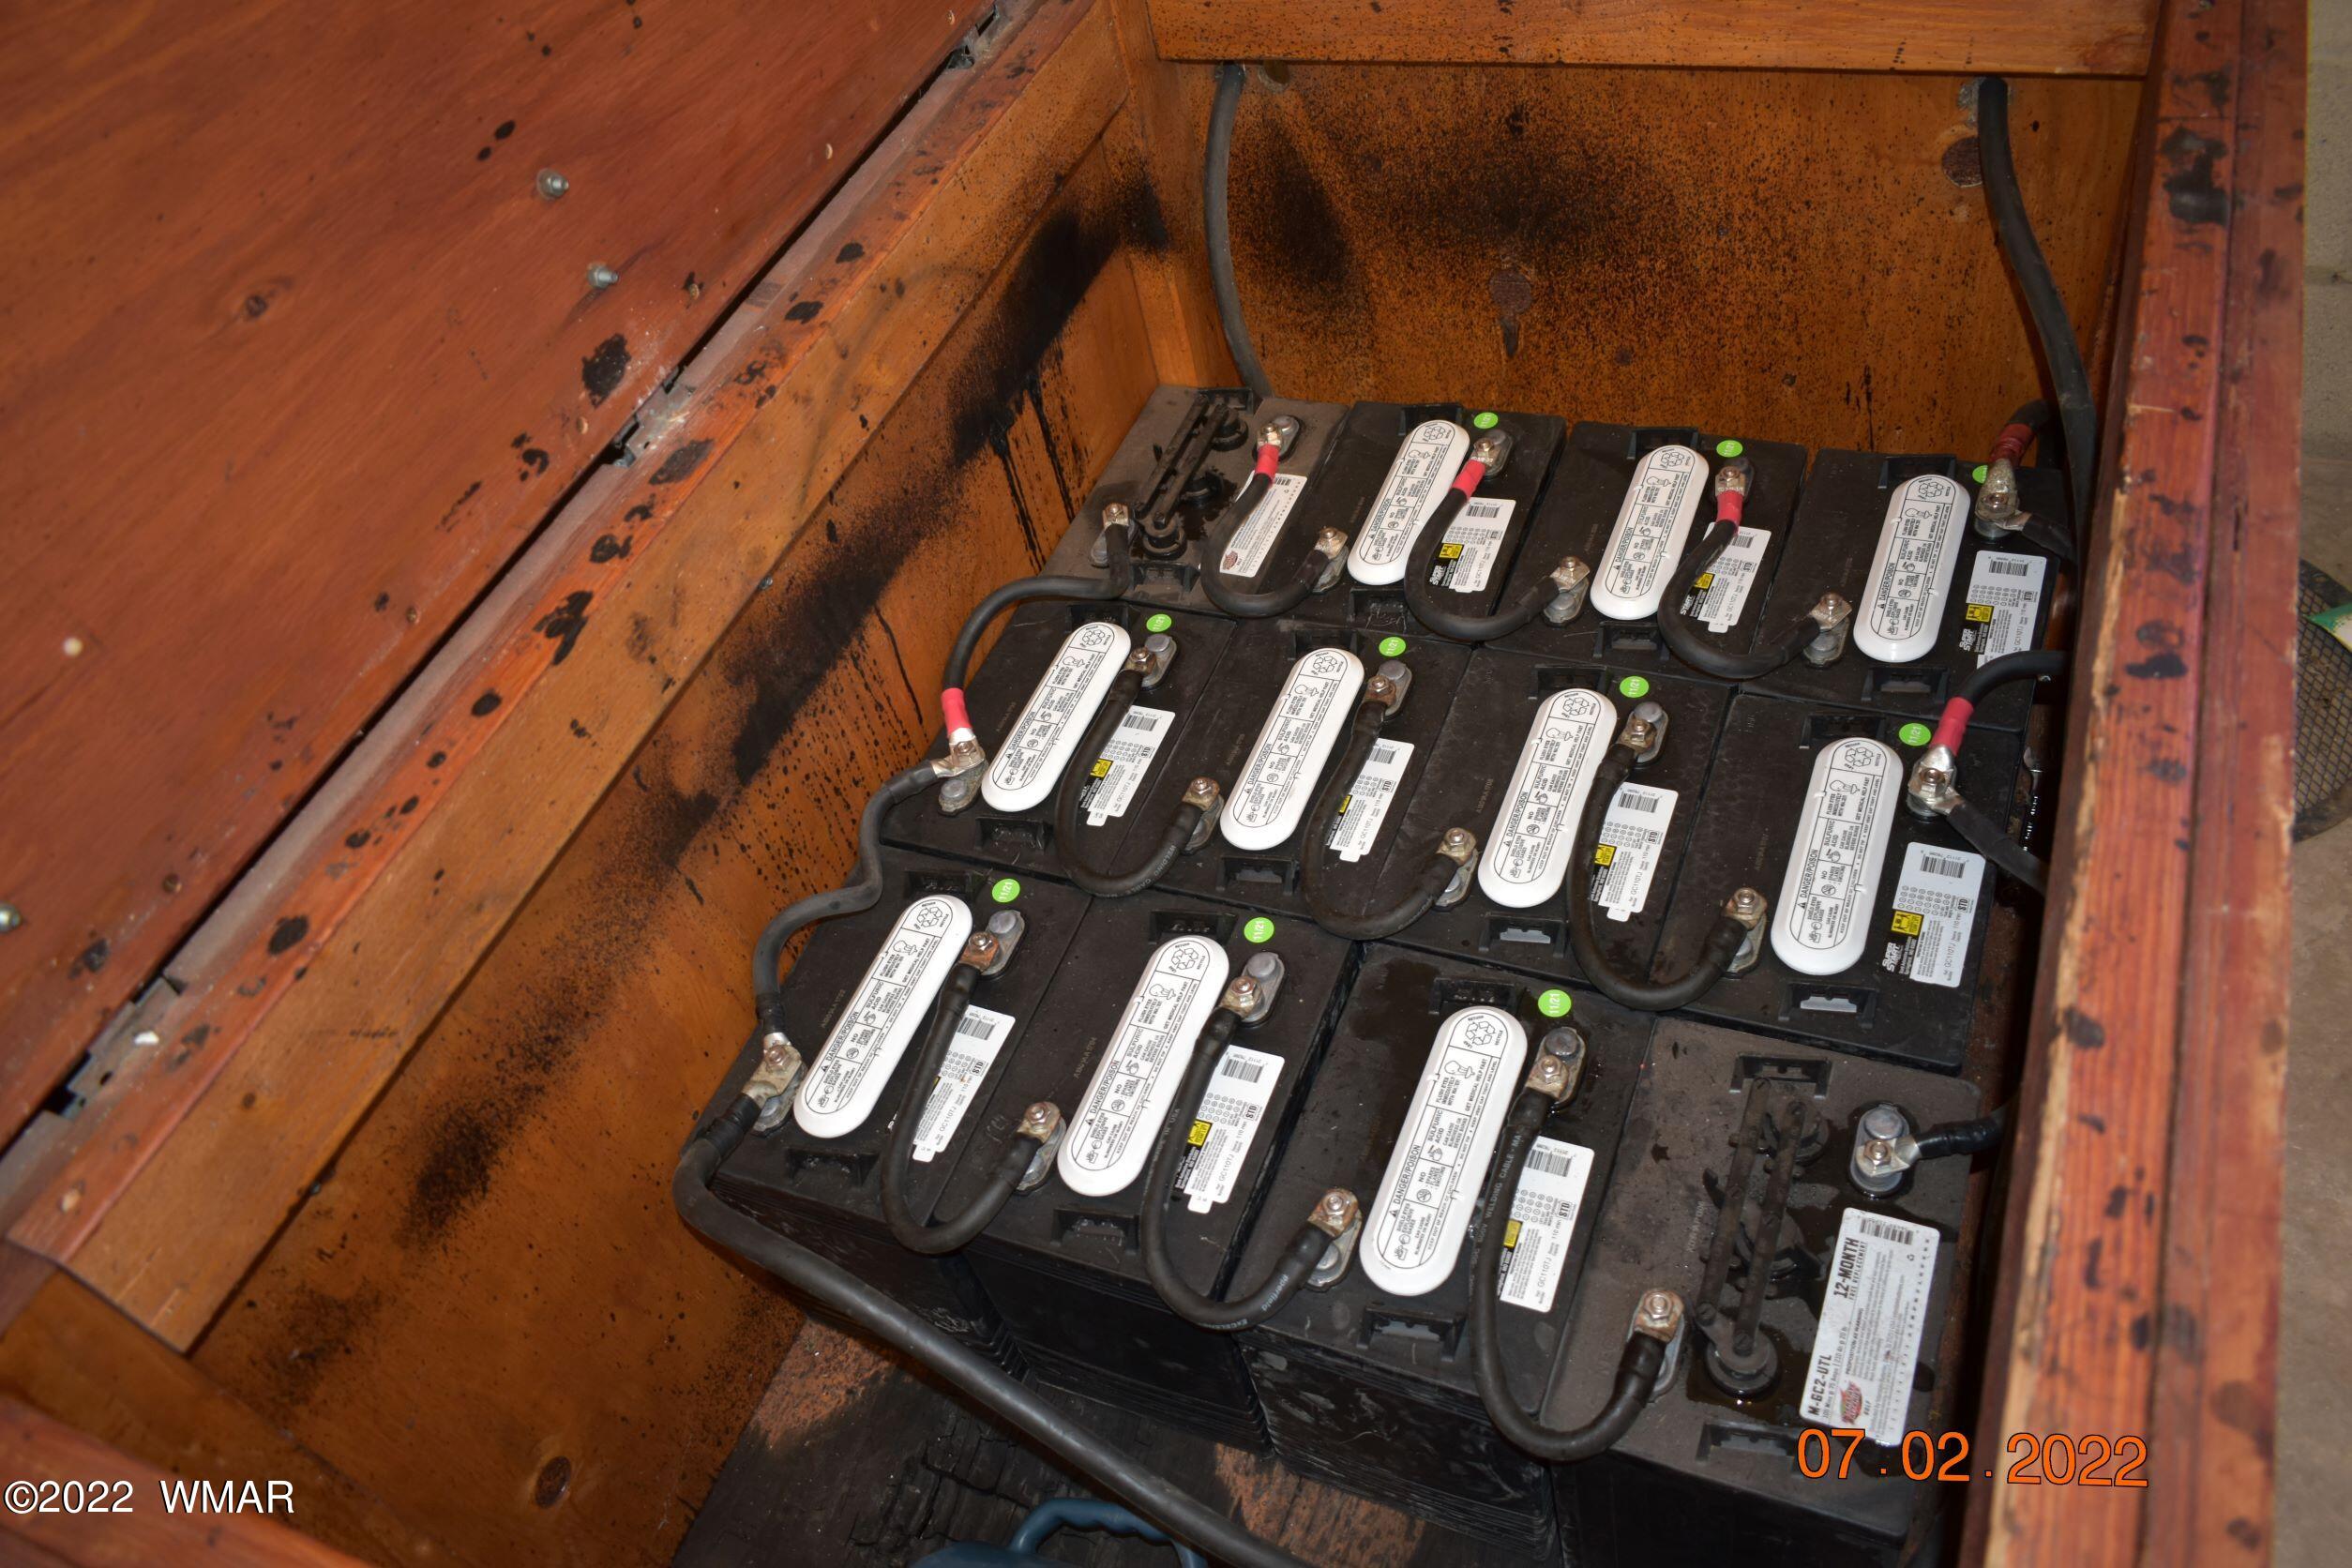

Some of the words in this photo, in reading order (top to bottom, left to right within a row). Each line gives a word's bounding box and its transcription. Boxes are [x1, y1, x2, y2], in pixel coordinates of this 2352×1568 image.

[1153, 616, 1165, 630] 11/21
[1386, 639, 1398, 655] 11/21
[1628, 678, 1640, 695] 11/21
[1907, 726, 1922, 744] 11/21
[1533, 764, 1546, 789] SULFURIC
[1539, 777, 1548, 790] ACID
[1505, 791, 1529, 837] DANGER/POISON
[1527, 810, 1534, 820] NO
[1823, 819, 1835, 846] SULFURIC
[1830, 833, 1838, 847] ACID
[1799, 848, 1818, 897] DANGER/POISON
[1820, 869, 1828, 879] NO
[998, 882, 1014, 901] 11/21
[1958, 898, 1968, 911] STD
[1253, 920, 1265, 940] 11/21
[1548, 992, 1560, 1014] 11/21
[825, 1011, 859, 1061] DANGER/POISON
[1125, 1028, 1144, 1057] SULFURIC
[1132, 1043, 1143, 1058] ACID
[1089, 1060, 1120, 1114] DANGER/POISON
[1113, 1082, 1123, 1093] NO
[1246, 1105, 1257, 1119] STD
[1426, 1108, 1443, 1141] SULFURIC
[1433, 1126, 1444, 1143] ACID
[1392, 1143, 1421, 1204] DANGER/POISON
[1417, 1170, 1426, 1183] NO
[1485, 1182, 1502, 1218] WELDING
[1500, 1154, 1515, 1178] CABLE
[1560, 1202, 1571, 1217] STD
[1832, 1236, 1860, 1299] 12-MONTH
[1851, 1240, 1866, 1284] REPLACEMENT
[1847, 1285, 1857, 1300] FREE
[1806, 1351, 1832, 1416] M-GC2-UTL
